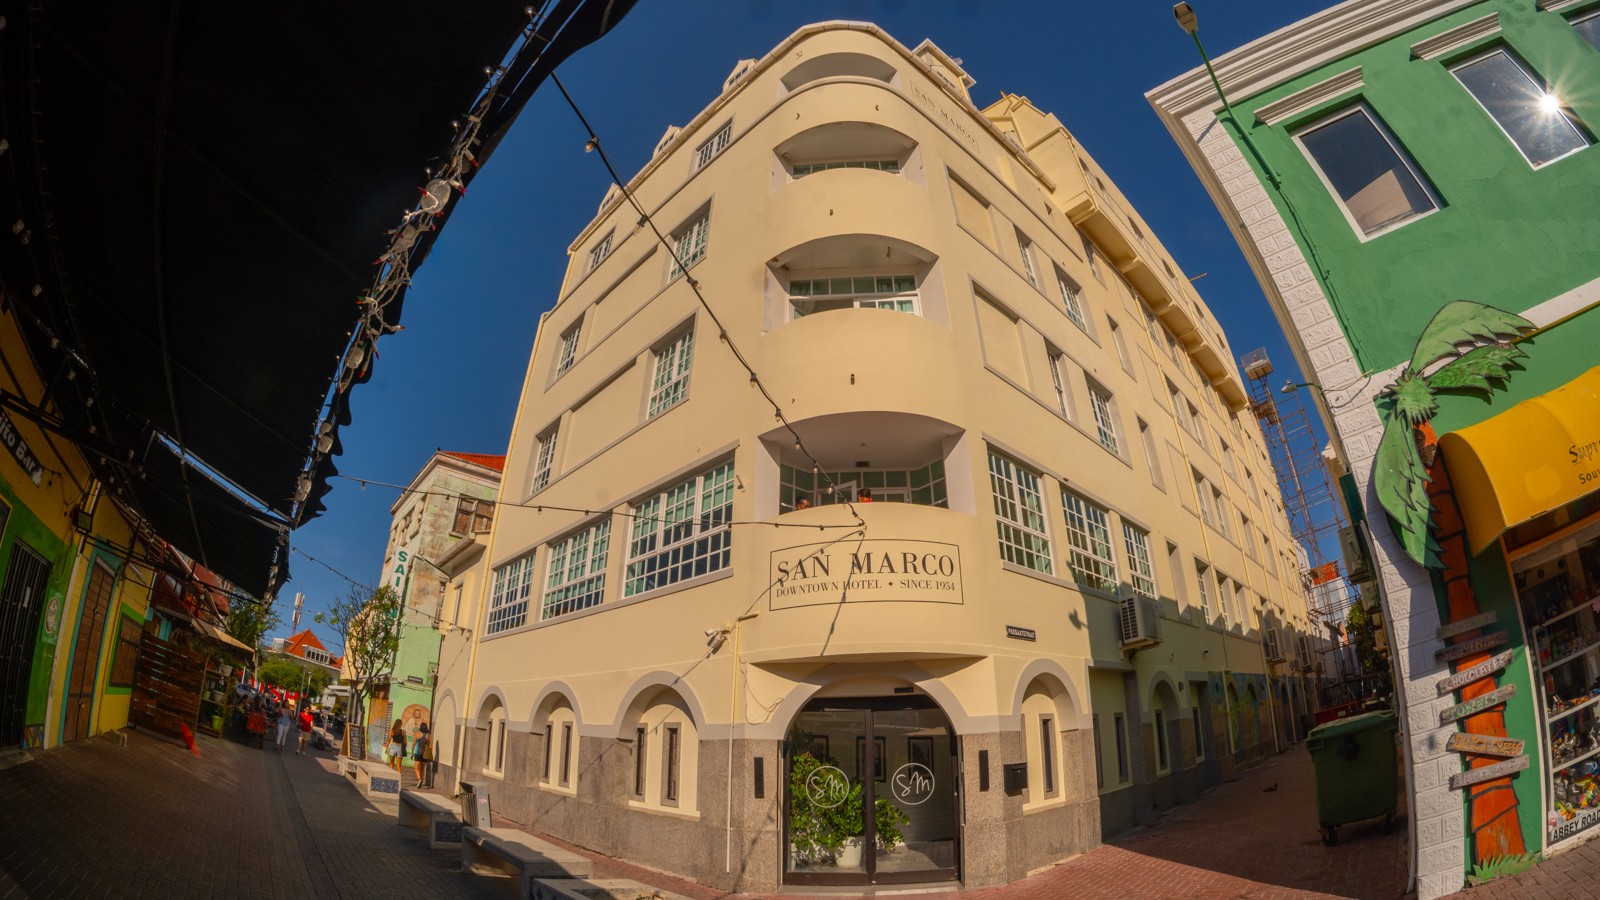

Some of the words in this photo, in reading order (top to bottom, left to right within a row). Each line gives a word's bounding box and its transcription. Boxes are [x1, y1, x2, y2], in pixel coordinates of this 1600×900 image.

[16, 440, 36, 473] Bar
[1569, 440, 1600, 464] Supr
[777, 555, 831, 582] SAN
[849, 552, 954, 577] MARCO
[776, 581, 839, 598] DOWNTOWN
[842, 579, 882, 590] HOTEL
[900, 579, 932, 589] SINCE
[935, 580, 955, 591] 1954
[1445, 655, 1506, 688] CHOCOLATES
[1449, 692, 1498, 720] TOWELS
[1455, 733, 1487, 752] DUTCH
[1552, 819, 1580, 841] ABBEY
